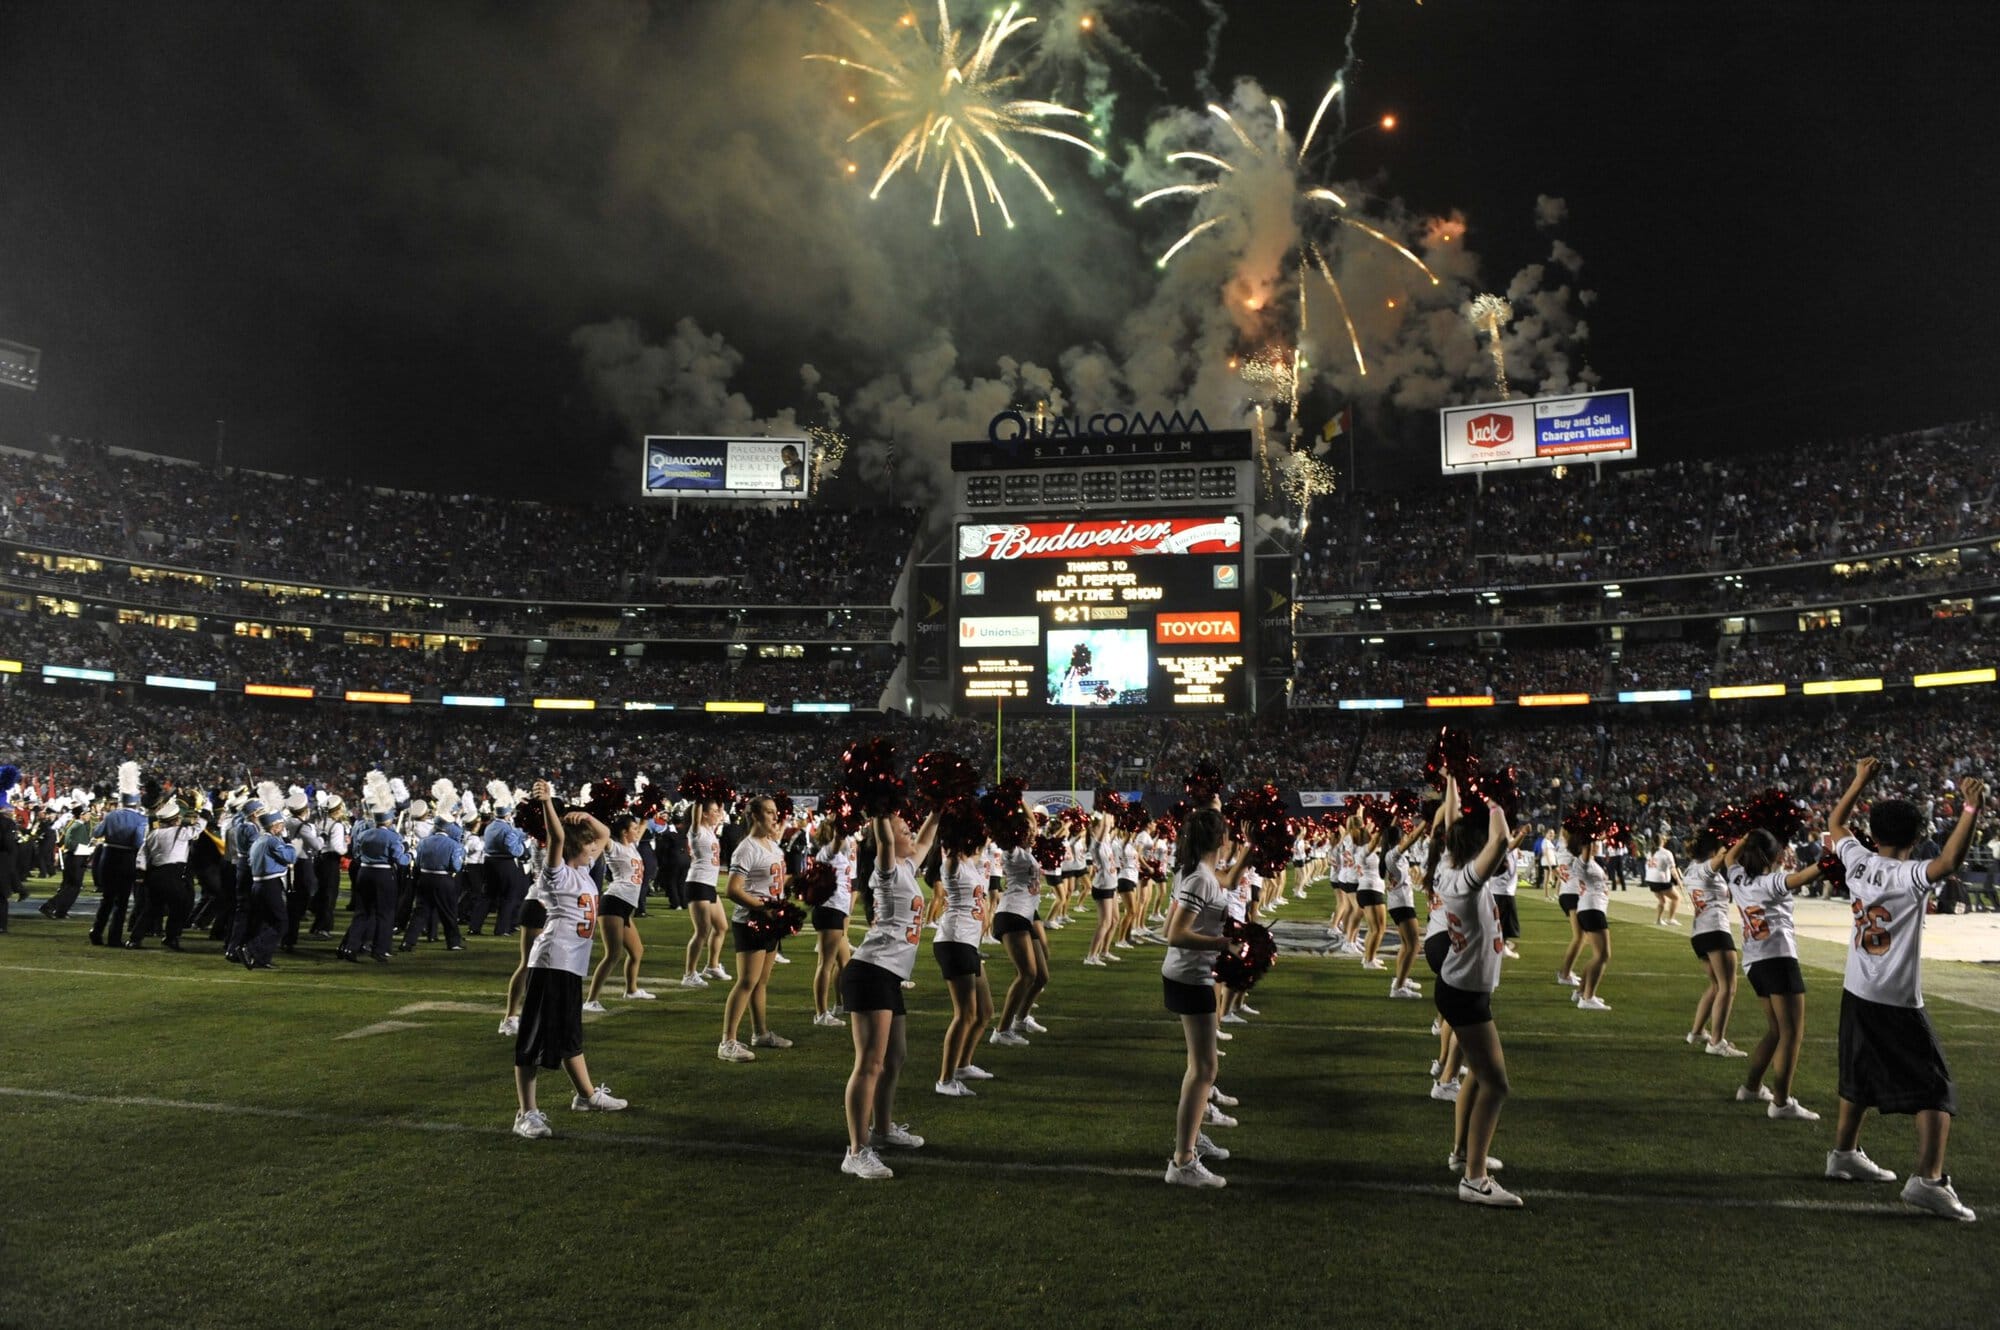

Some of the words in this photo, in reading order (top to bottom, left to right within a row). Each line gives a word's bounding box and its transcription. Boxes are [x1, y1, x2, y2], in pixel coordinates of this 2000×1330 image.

[1554, 419, 1571, 430] Buy
[1573, 416, 1591, 427] and
[1593, 414, 1612, 425] Sell
[988, 409, 1211, 454] QUALCOMM
[1469, 416, 1512, 444] Jack
[1542, 430, 1585, 442] Chargers
[1586, 425, 1624, 438] Tickets!
[730, 446, 780, 454] PALOMAR
[1035, 441, 1192, 456] STADIUM
[1496, 448, 1511, 456] box
[651, 454, 723, 470] QUALCOMM
[730, 464, 780, 472] HEALTH
[985, 520, 1171, 560] Budweiser
[1066, 562, 1109, 572] THANKS
[1112, 561, 1128, 571] TO
[1056, 575, 1077, 587] DR
[1082, 573, 1137, 587] PEPPER
[1036, 588, 1114, 602] HALFTIME
[1122, 587, 1163, 600] SHOW
[980, 626, 1036, 637] UnionBa
[1160, 620, 1236, 637] TOYOTA
[576, 893, 600, 939] 3
